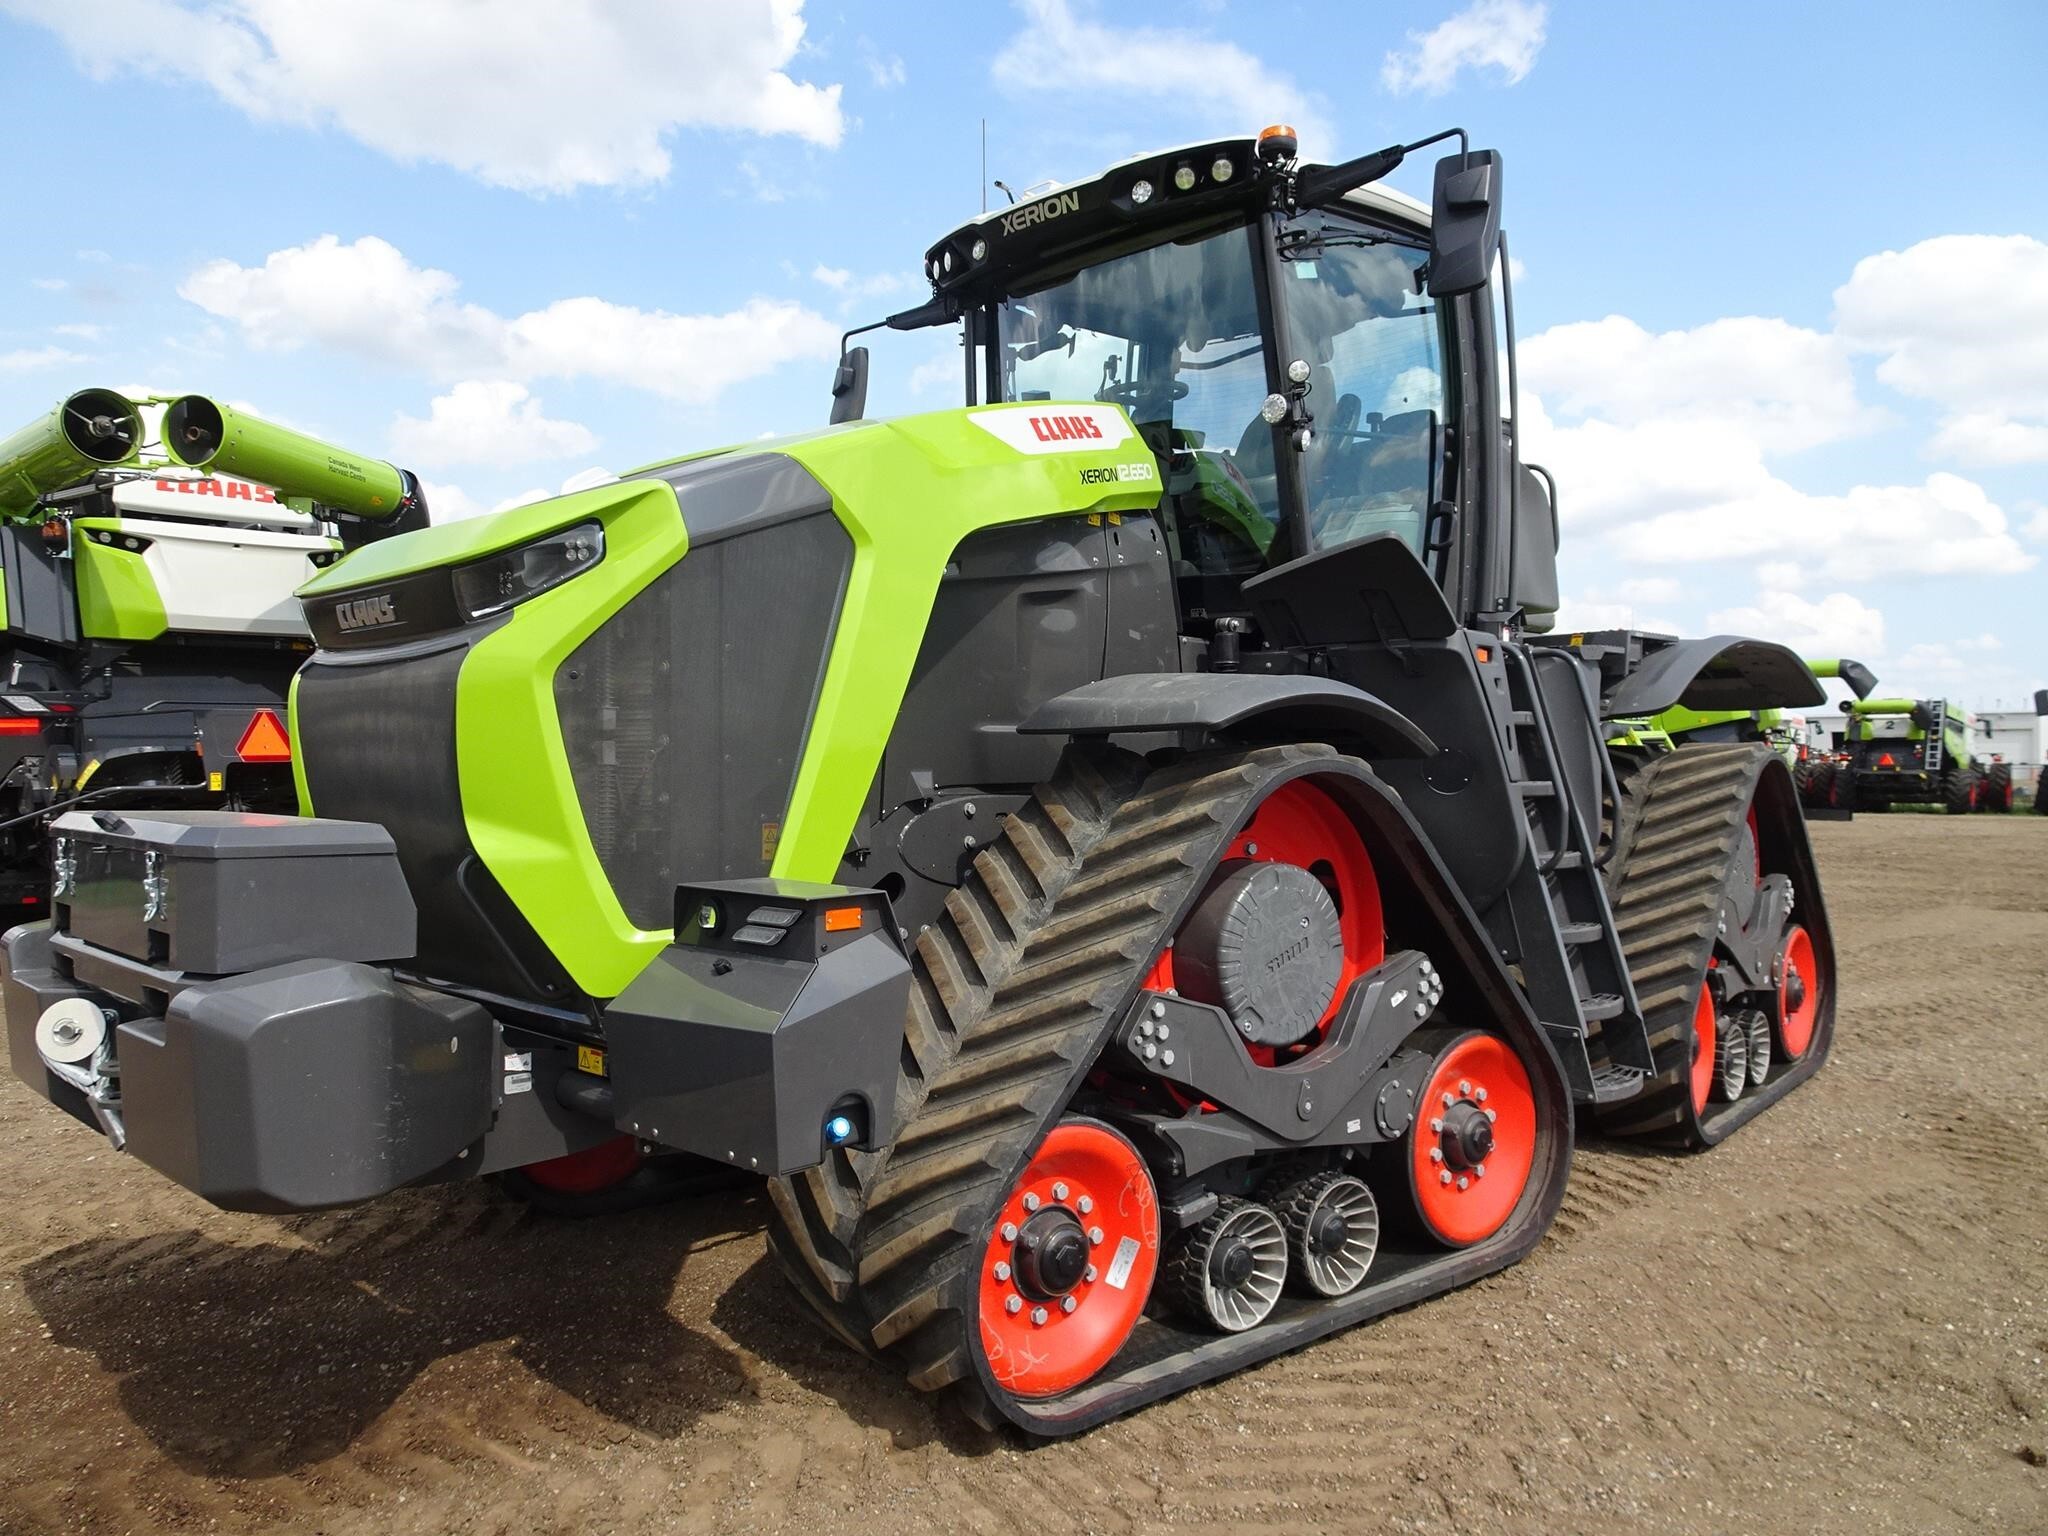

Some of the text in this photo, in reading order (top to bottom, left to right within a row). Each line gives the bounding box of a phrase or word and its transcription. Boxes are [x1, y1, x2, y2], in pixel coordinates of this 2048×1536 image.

[1000, 191, 1080, 237] XERION
[1029, 416, 1103, 441] CLAAS
[328, 456, 348, 469] Canada
[1080, 463, 1153, 484] XERION 12.650
[335, 594, 396, 630] CLAAS
[1885, 720, 1895, 730] 2
